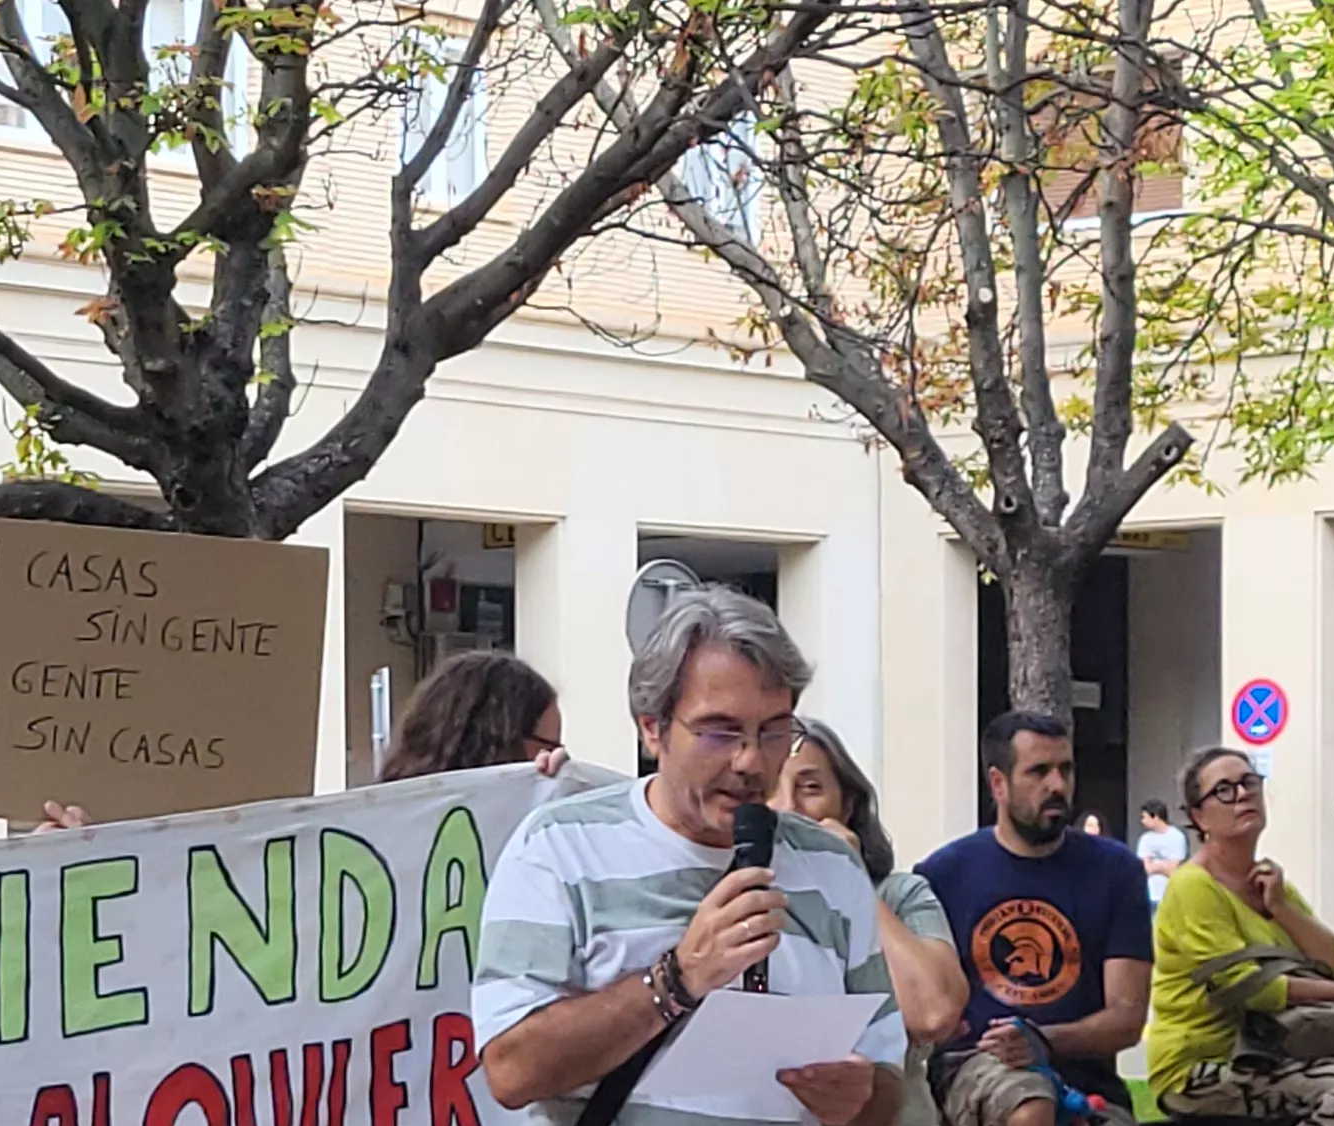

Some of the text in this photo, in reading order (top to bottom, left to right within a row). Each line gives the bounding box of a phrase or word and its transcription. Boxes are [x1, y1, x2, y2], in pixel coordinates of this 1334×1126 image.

[26, 550, 159, 598] CASAS
[160, 616, 279, 657] GENTE
[11, 661, 140, 701] GENTE
[12, 715, 225, 769] SIN CASAS
